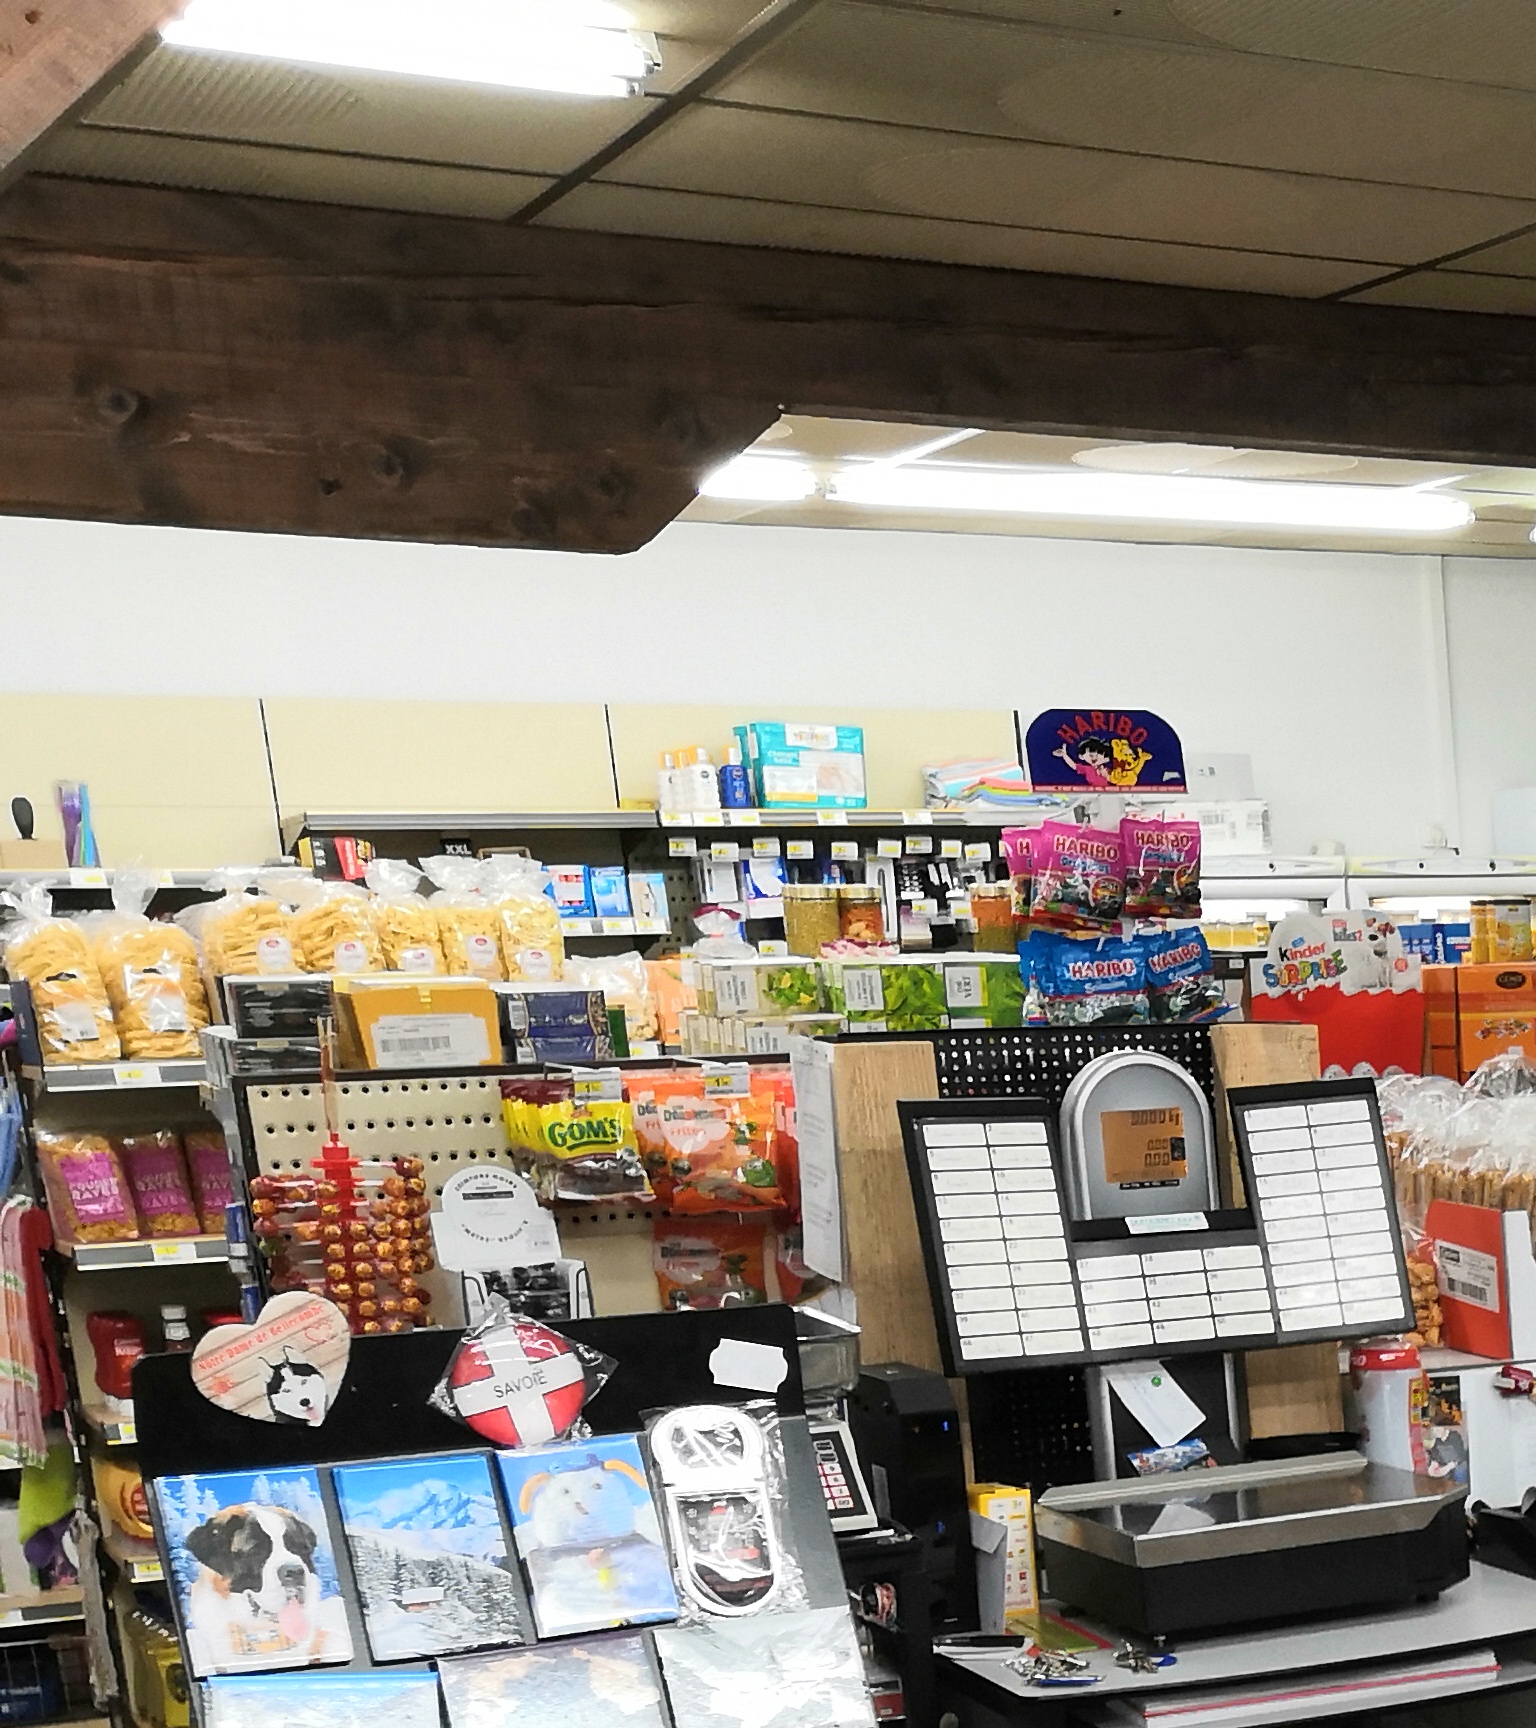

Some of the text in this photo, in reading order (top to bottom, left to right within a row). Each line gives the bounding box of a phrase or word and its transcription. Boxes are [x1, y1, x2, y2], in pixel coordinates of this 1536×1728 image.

[1057, 711, 1148, 746] HARIBO
[445, 843, 472, 856] XXL
[1054, 834, 1119, 861] HARIBO
[1134, 829, 1190, 850] HARIBO
[1069, 957, 1137, 979] HARIBO
[1150, 942, 1202, 974] HARIBO
[1262, 949, 1348, 988] SURPRISE
[548, 1115, 621, 1148] GOM'S
